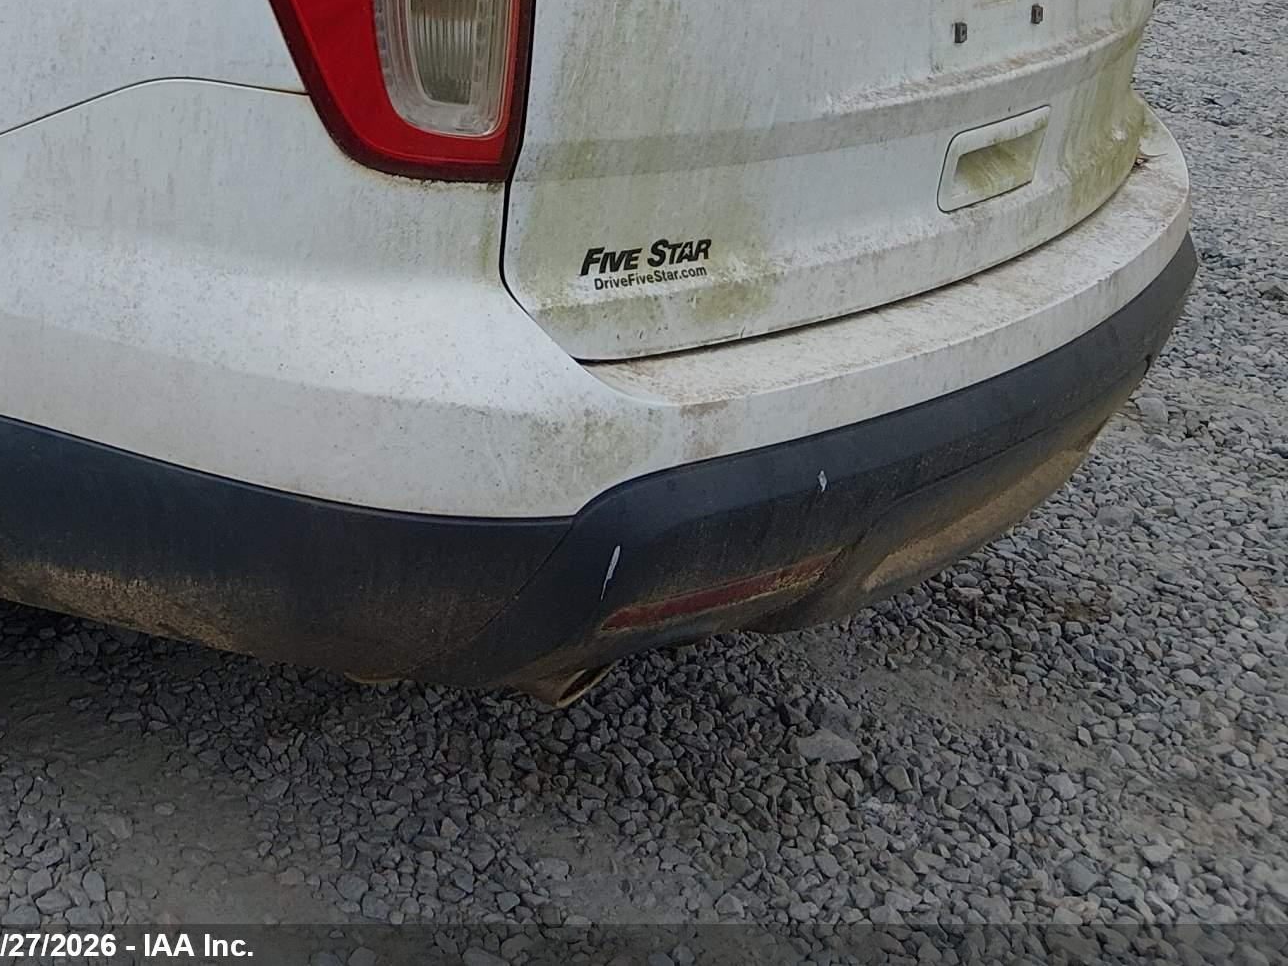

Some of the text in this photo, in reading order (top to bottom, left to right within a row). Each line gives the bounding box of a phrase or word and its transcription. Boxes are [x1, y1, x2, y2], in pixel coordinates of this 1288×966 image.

[580, 239, 712, 277] FIVE STAR
[594, 265, 707, 291] DriveFiveStar.com
